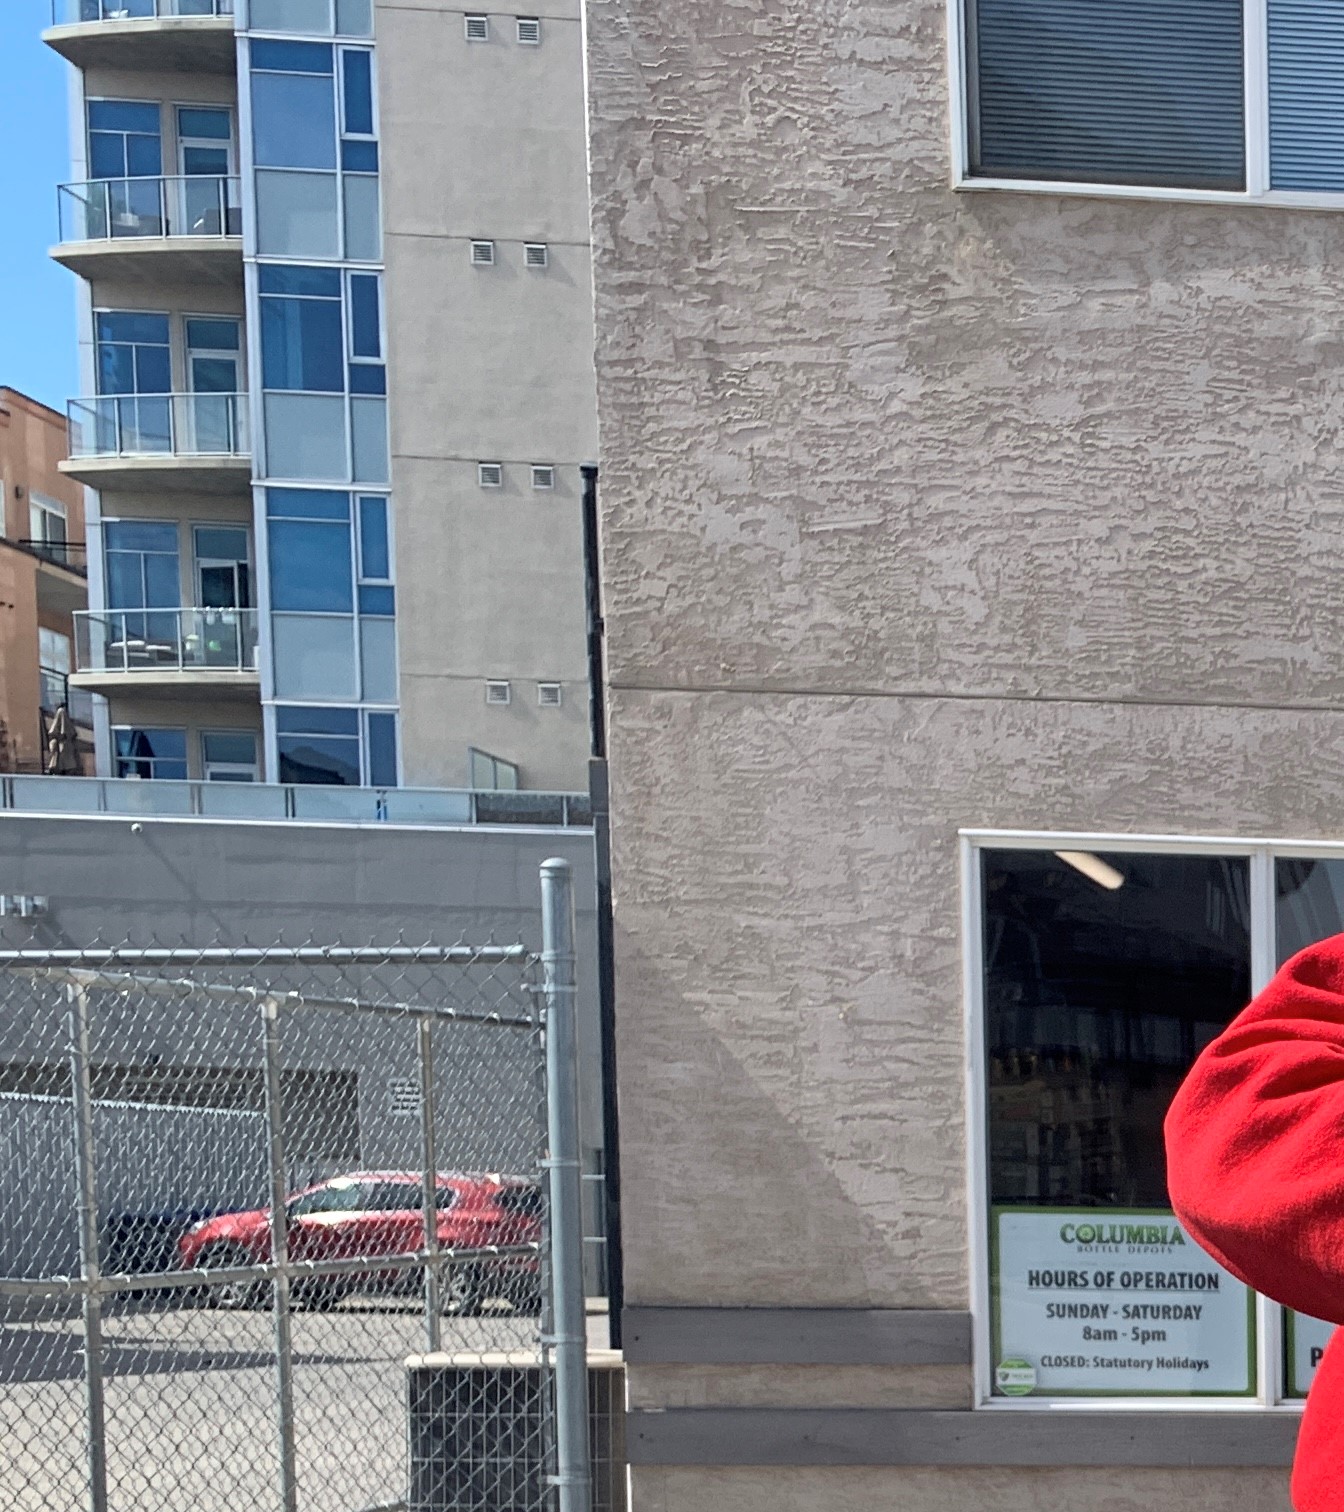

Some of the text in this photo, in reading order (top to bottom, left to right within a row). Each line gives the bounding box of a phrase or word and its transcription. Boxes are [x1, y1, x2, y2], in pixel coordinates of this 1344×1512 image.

[1060, 1223, 1185, 1245] COLUMBIA
[1027, 1270, 1219, 1289] HOURS OF OPERATION
[1046, 1303, 1202, 1320] SUNDAY SATURDAY
[1082, 1326, 1167, 1345] 8am 5pm
[1040, 1355, 1210, 1372] CLOSED: Statutory Holidays
